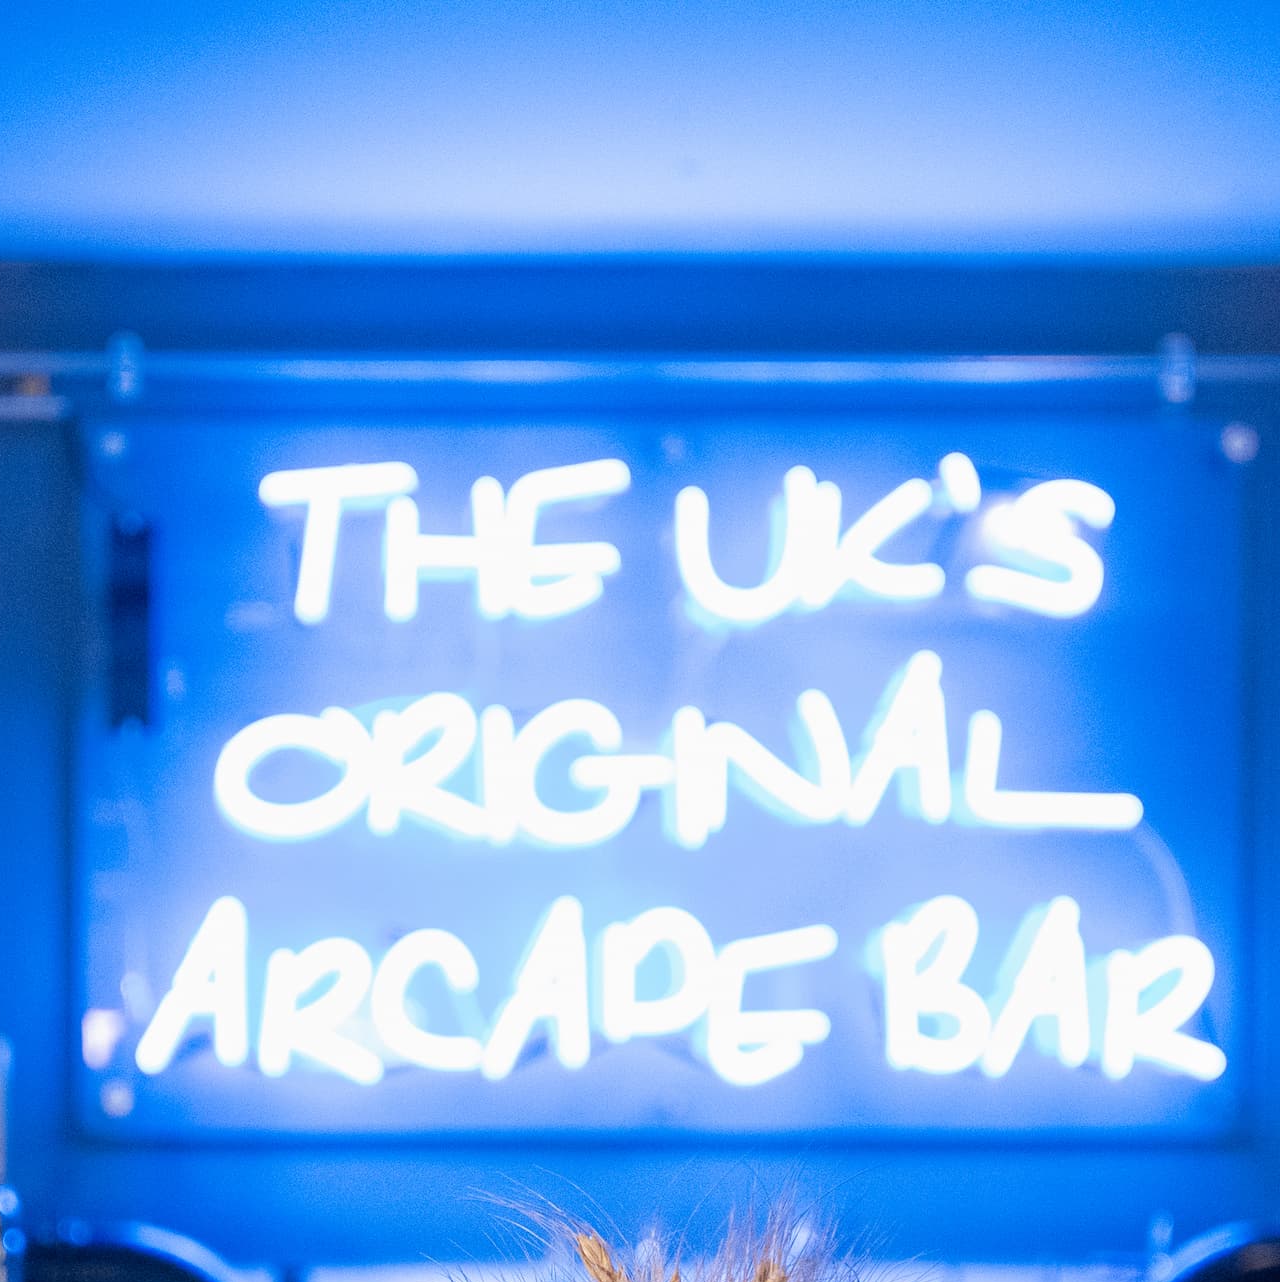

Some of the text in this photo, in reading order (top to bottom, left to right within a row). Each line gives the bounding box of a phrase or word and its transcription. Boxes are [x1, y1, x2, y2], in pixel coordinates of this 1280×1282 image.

[258, 452, 1114, 628] THE UK'S
[213, 651, 1143, 848] ORIGINAL
[136, 894, 1227, 1086] ARCADE BAR
